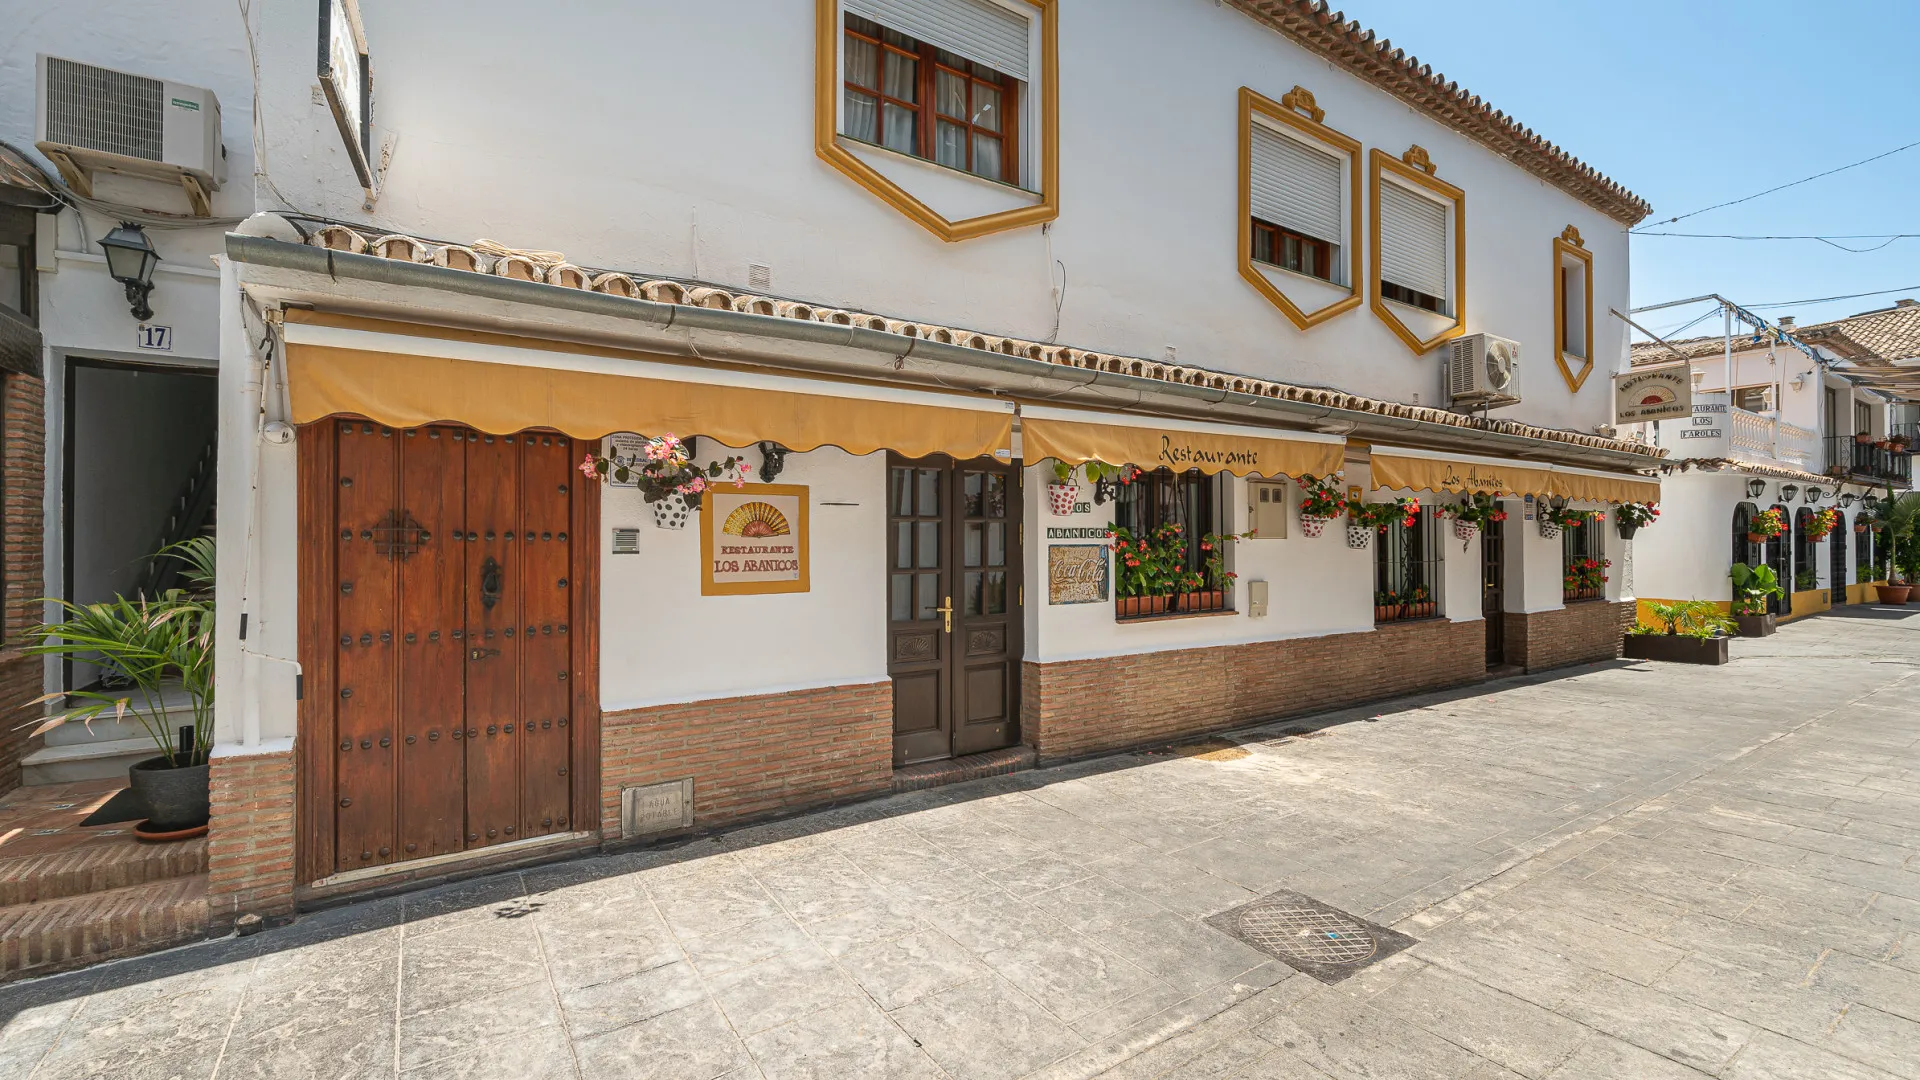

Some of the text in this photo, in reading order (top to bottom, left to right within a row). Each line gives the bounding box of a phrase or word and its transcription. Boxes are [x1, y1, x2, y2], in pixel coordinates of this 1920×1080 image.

[145, 327, 166, 346] 17
[1694, 404, 1727, 413] AURANTE
[1620, 410, 1636, 418] LOS
[1694, 417, 1711, 426] LOS
[1682, 430, 1720, 438] FAROLES
[1159, 434, 1258, 466] Restaurante
[1441, 465, 1460, 489] Los
[1072, 503, 1090, 512] OS
[721, 545, 795, 555] RESTAURANTE
[714, 560, 799, 573] LOS ABANICOS
[648, 796, 671, 809] AGUA
